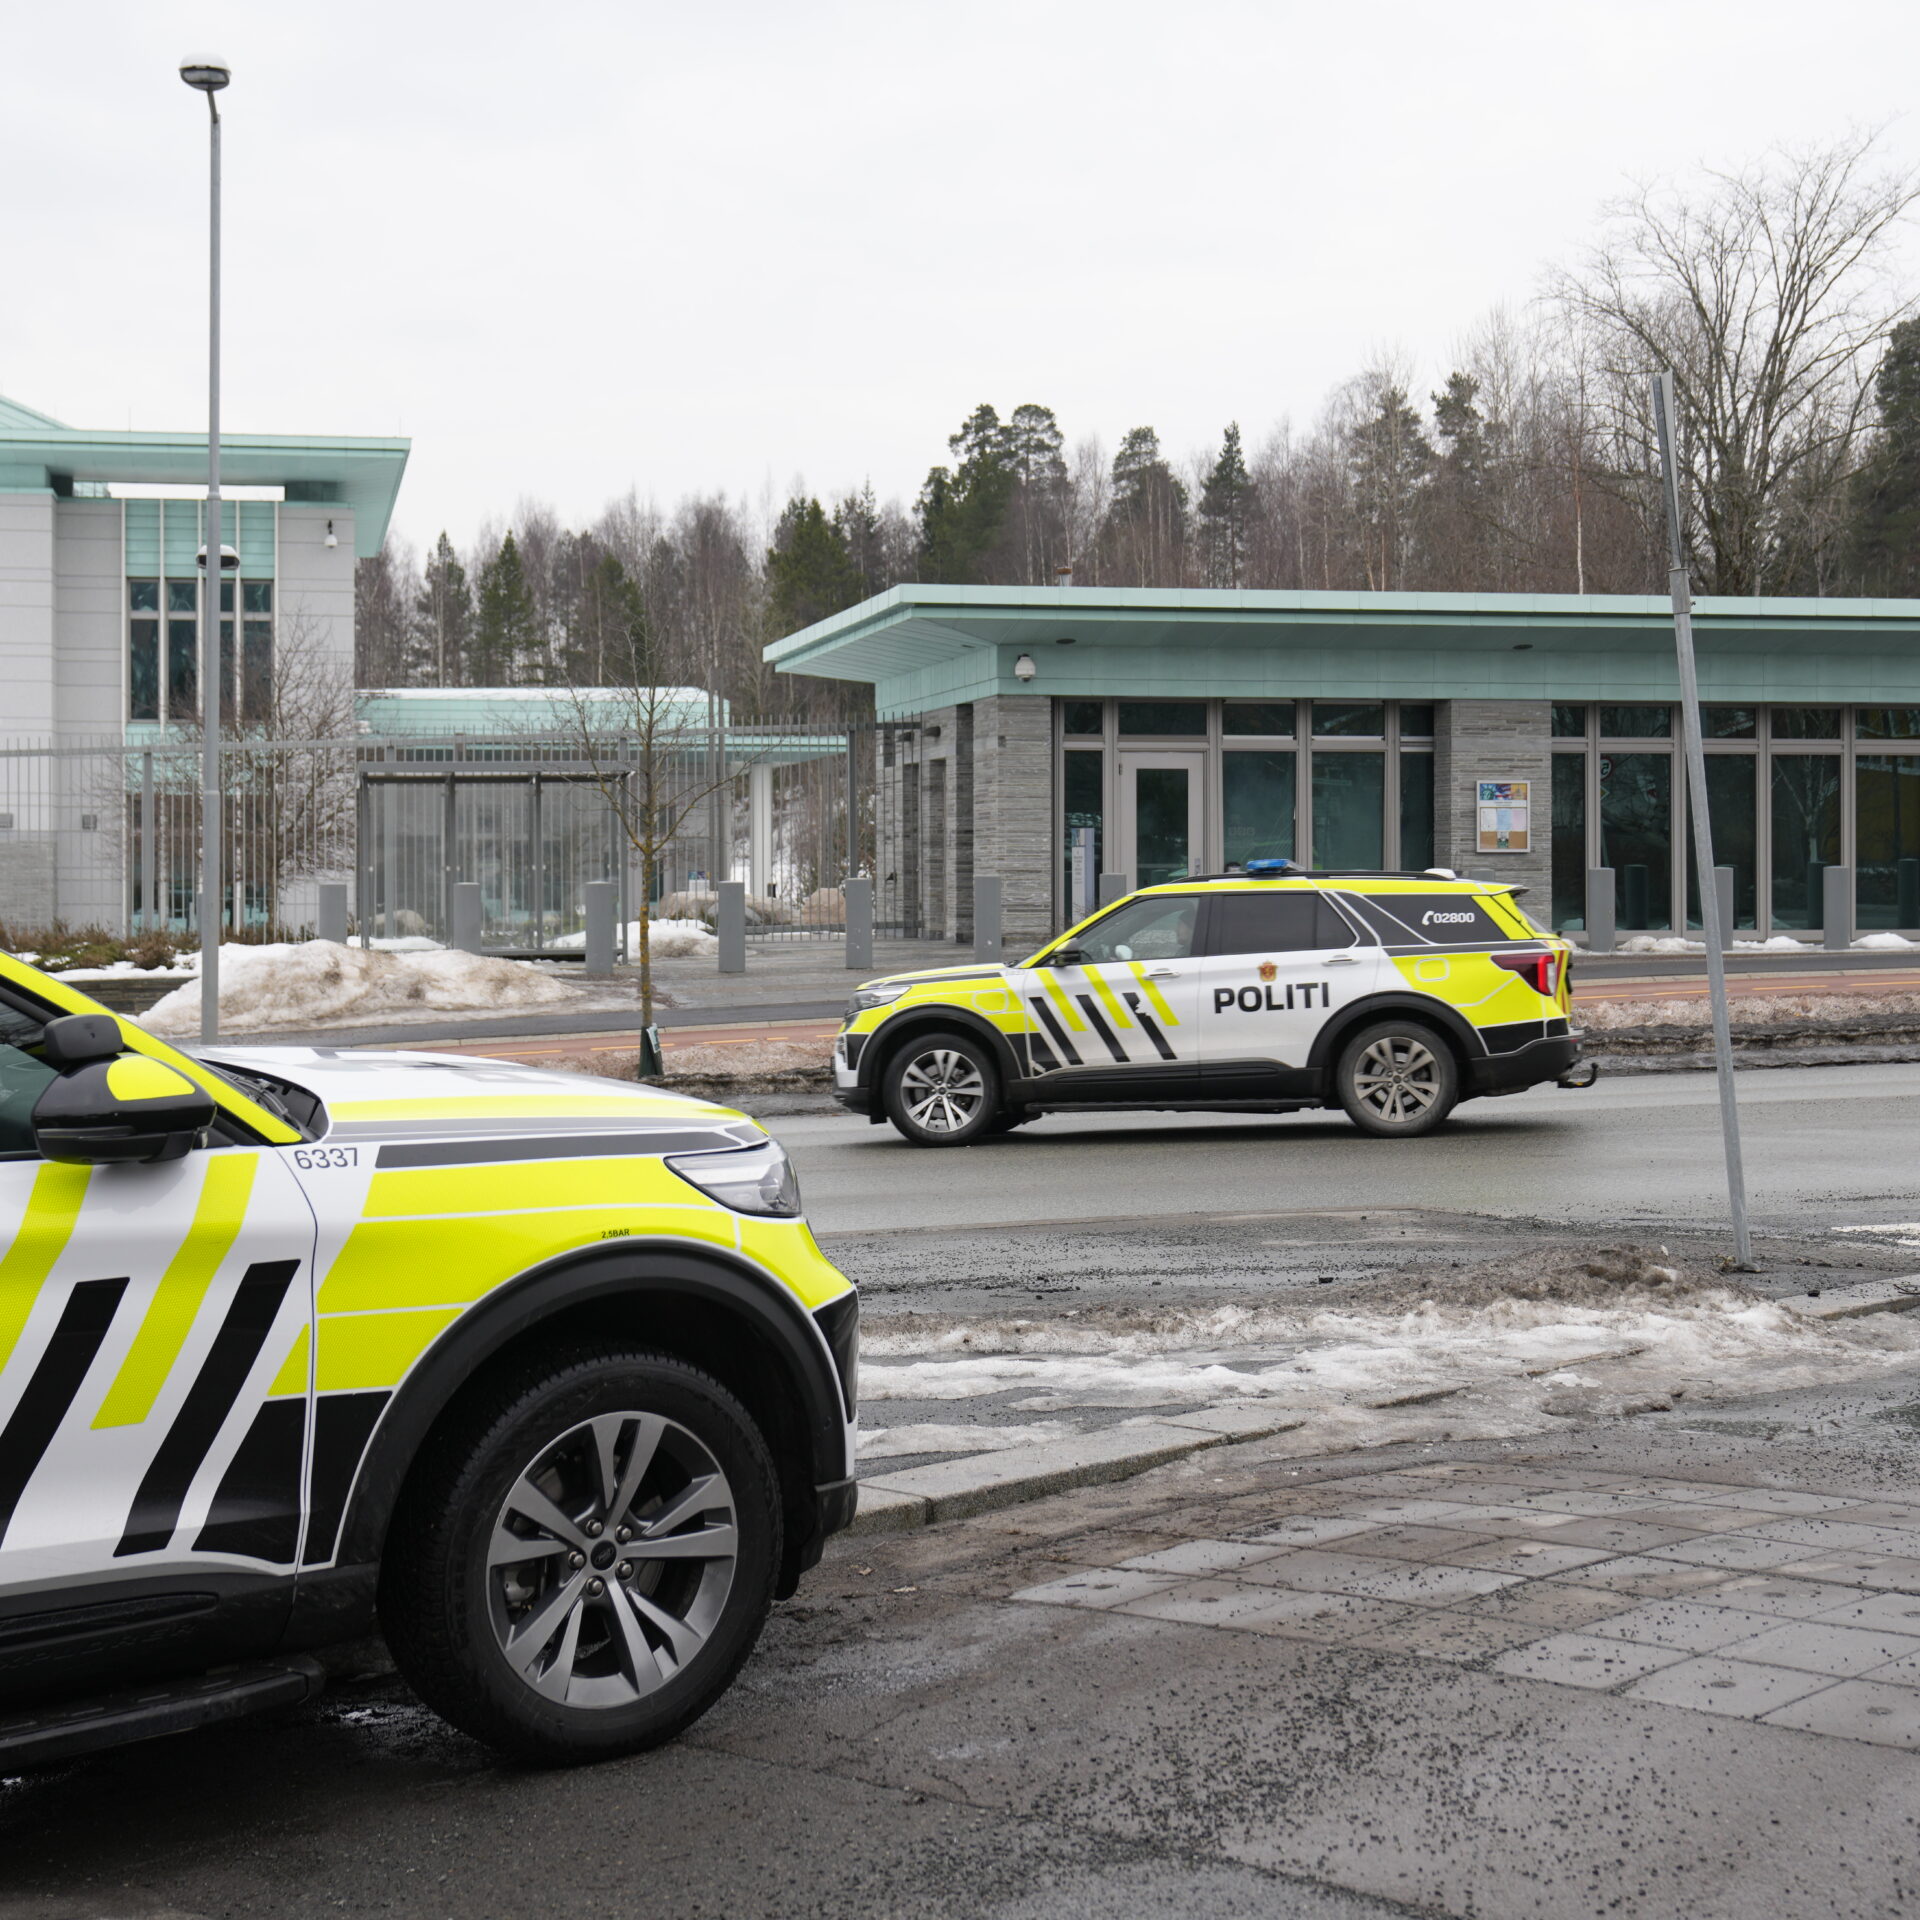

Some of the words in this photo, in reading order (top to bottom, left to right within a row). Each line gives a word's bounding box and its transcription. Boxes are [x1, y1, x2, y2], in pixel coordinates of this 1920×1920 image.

[1433, 912, 1476, 924] 02800
[1213, 981, 1330, 1014] POLITI
[294, 1147, 358, 1170] 6337
